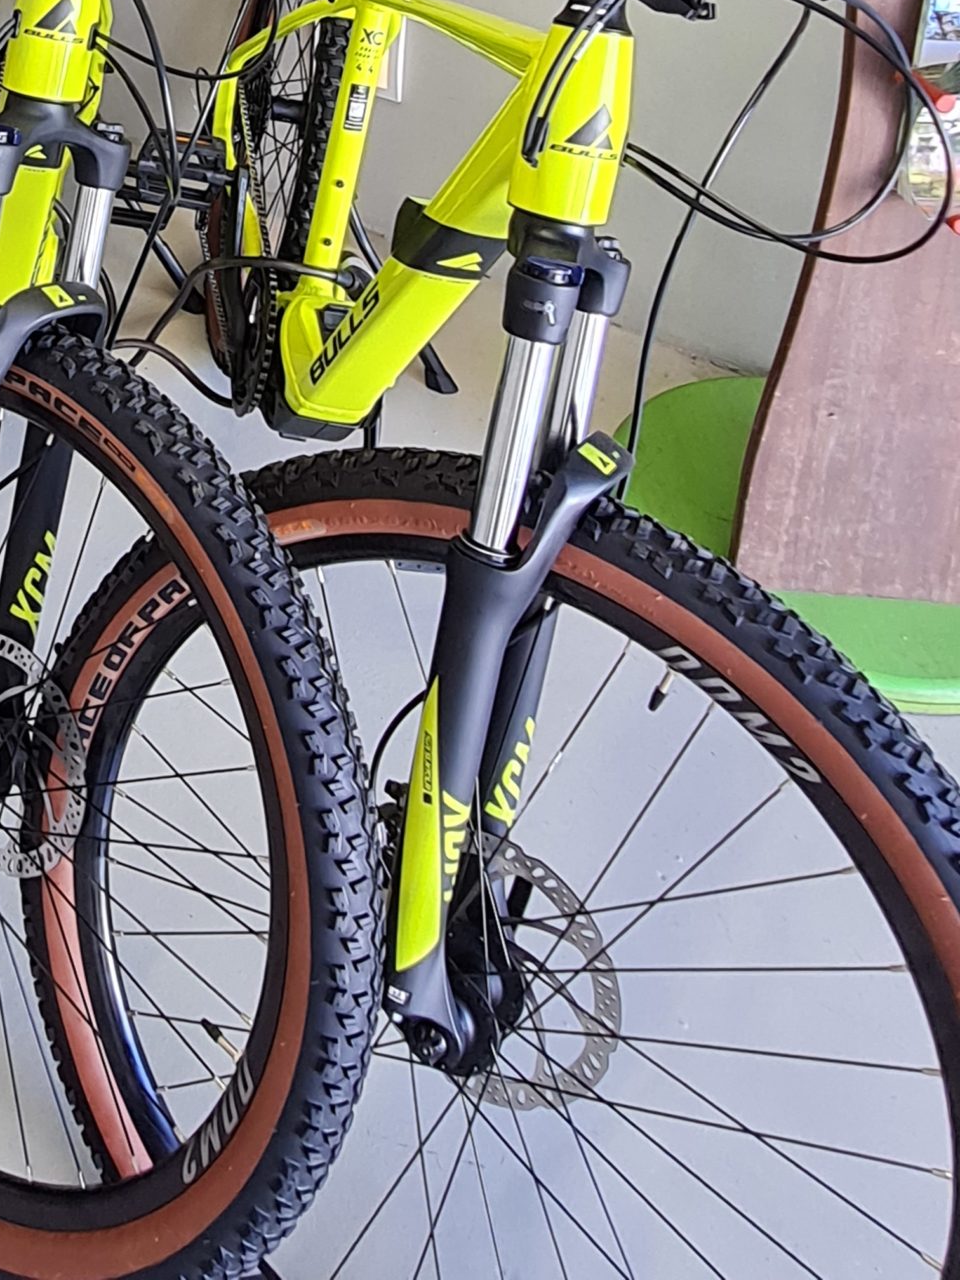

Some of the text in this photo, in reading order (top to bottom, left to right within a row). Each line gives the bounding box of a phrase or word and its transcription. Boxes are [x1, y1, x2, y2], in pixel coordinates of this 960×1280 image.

[23, 28, 84, 44] BULLS
[549, 144, 618, 160] BULLS
[310, 280, 380, 386] BULLS
[4, 373, 107, 440] PACE
